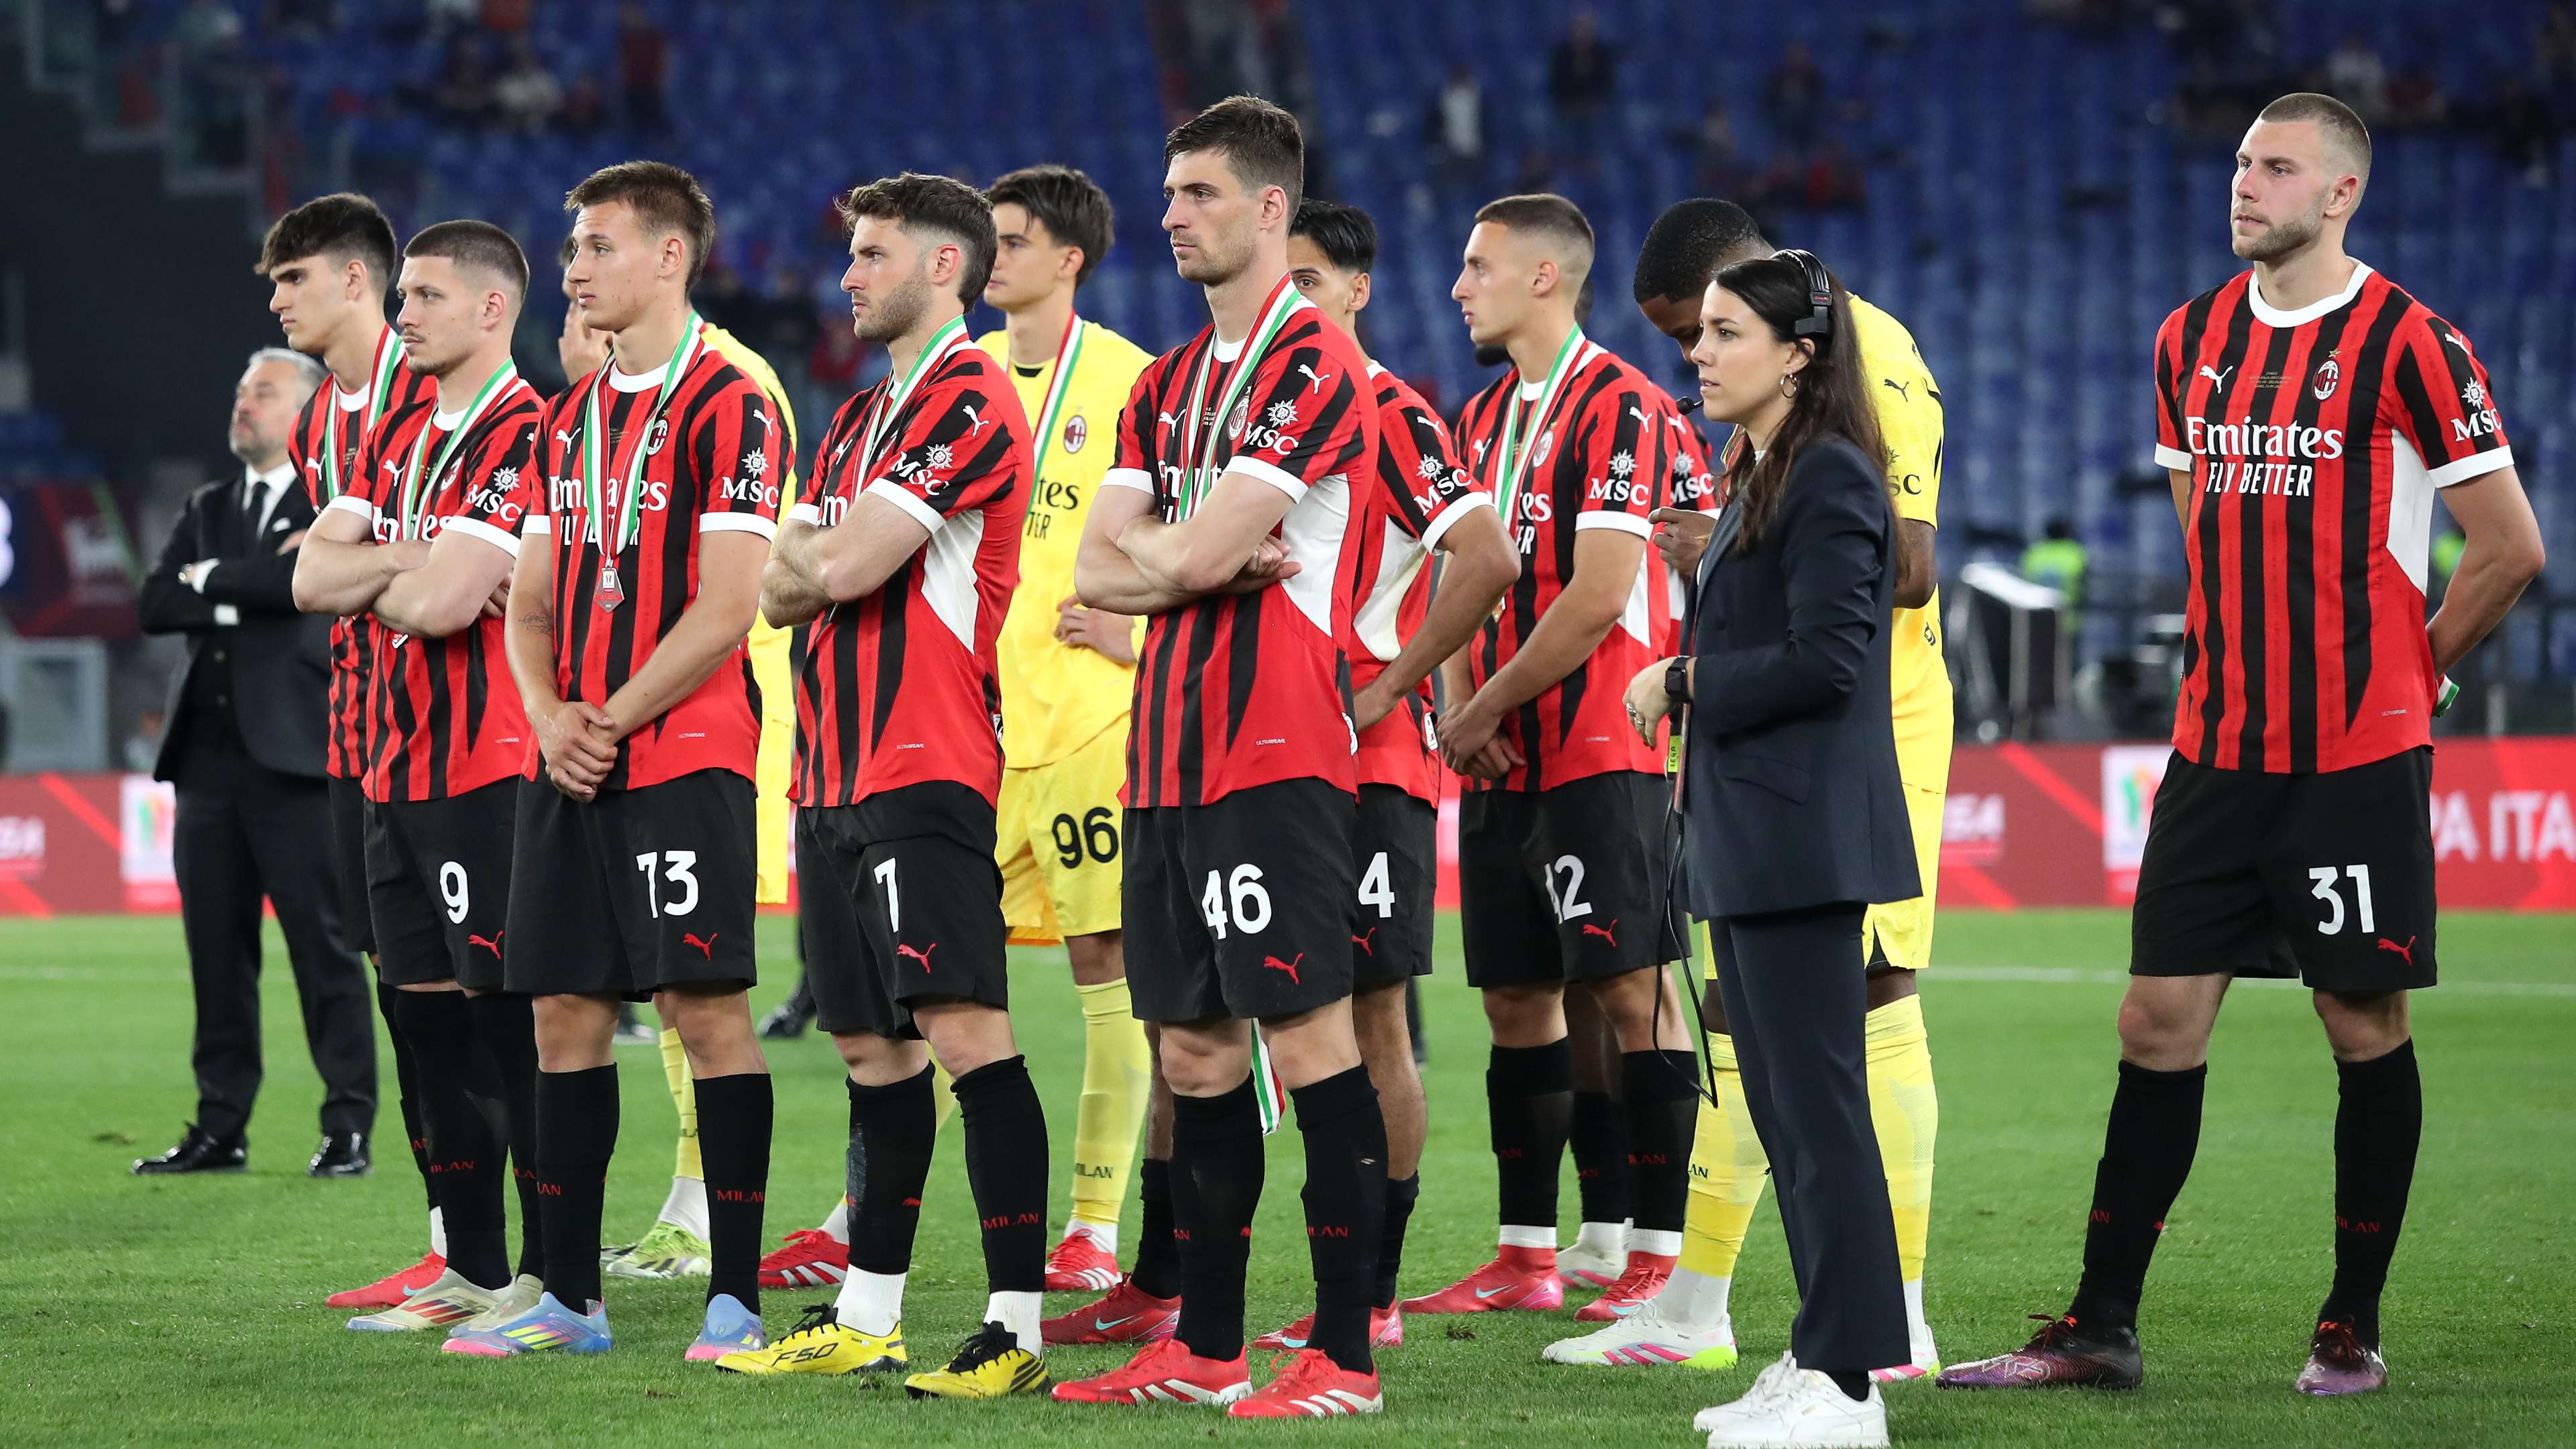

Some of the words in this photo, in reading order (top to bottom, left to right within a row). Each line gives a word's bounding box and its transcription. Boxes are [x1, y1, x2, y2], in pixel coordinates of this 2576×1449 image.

[1243, 421, 1299, 455] MSC
[2186, 416, 2343, 460] Emirates
[2451, 408, 2502, 441] MSC
[720, 476, 780, 509] MSC
[890, 450, 950, 496] MSC
[1413, 468, 1472, 517] MSC
[1588, 477, 1649, 506] MSC
[1671, 472, 1715, 503] MSC
[1887, 474, 1922, 496] SC
[2206, 462, 2237, 494] FLY
[2238, 463, 2313, 498] BETTER
[466, 483, 523, 523] MSC
[1052, 806, 1119, 869] 96
[2488, 790, 2576, 863] ITA
[439, 861, 470, 924] 9
[1201, 863, 1273, 941] 46
[1358, 851, 1396, 919] 4
[2308, 863, 2375, 935] 31
[716, 1190, 764, 1203] MILAN
[983, 1213, 1039, 1230] MILAN
